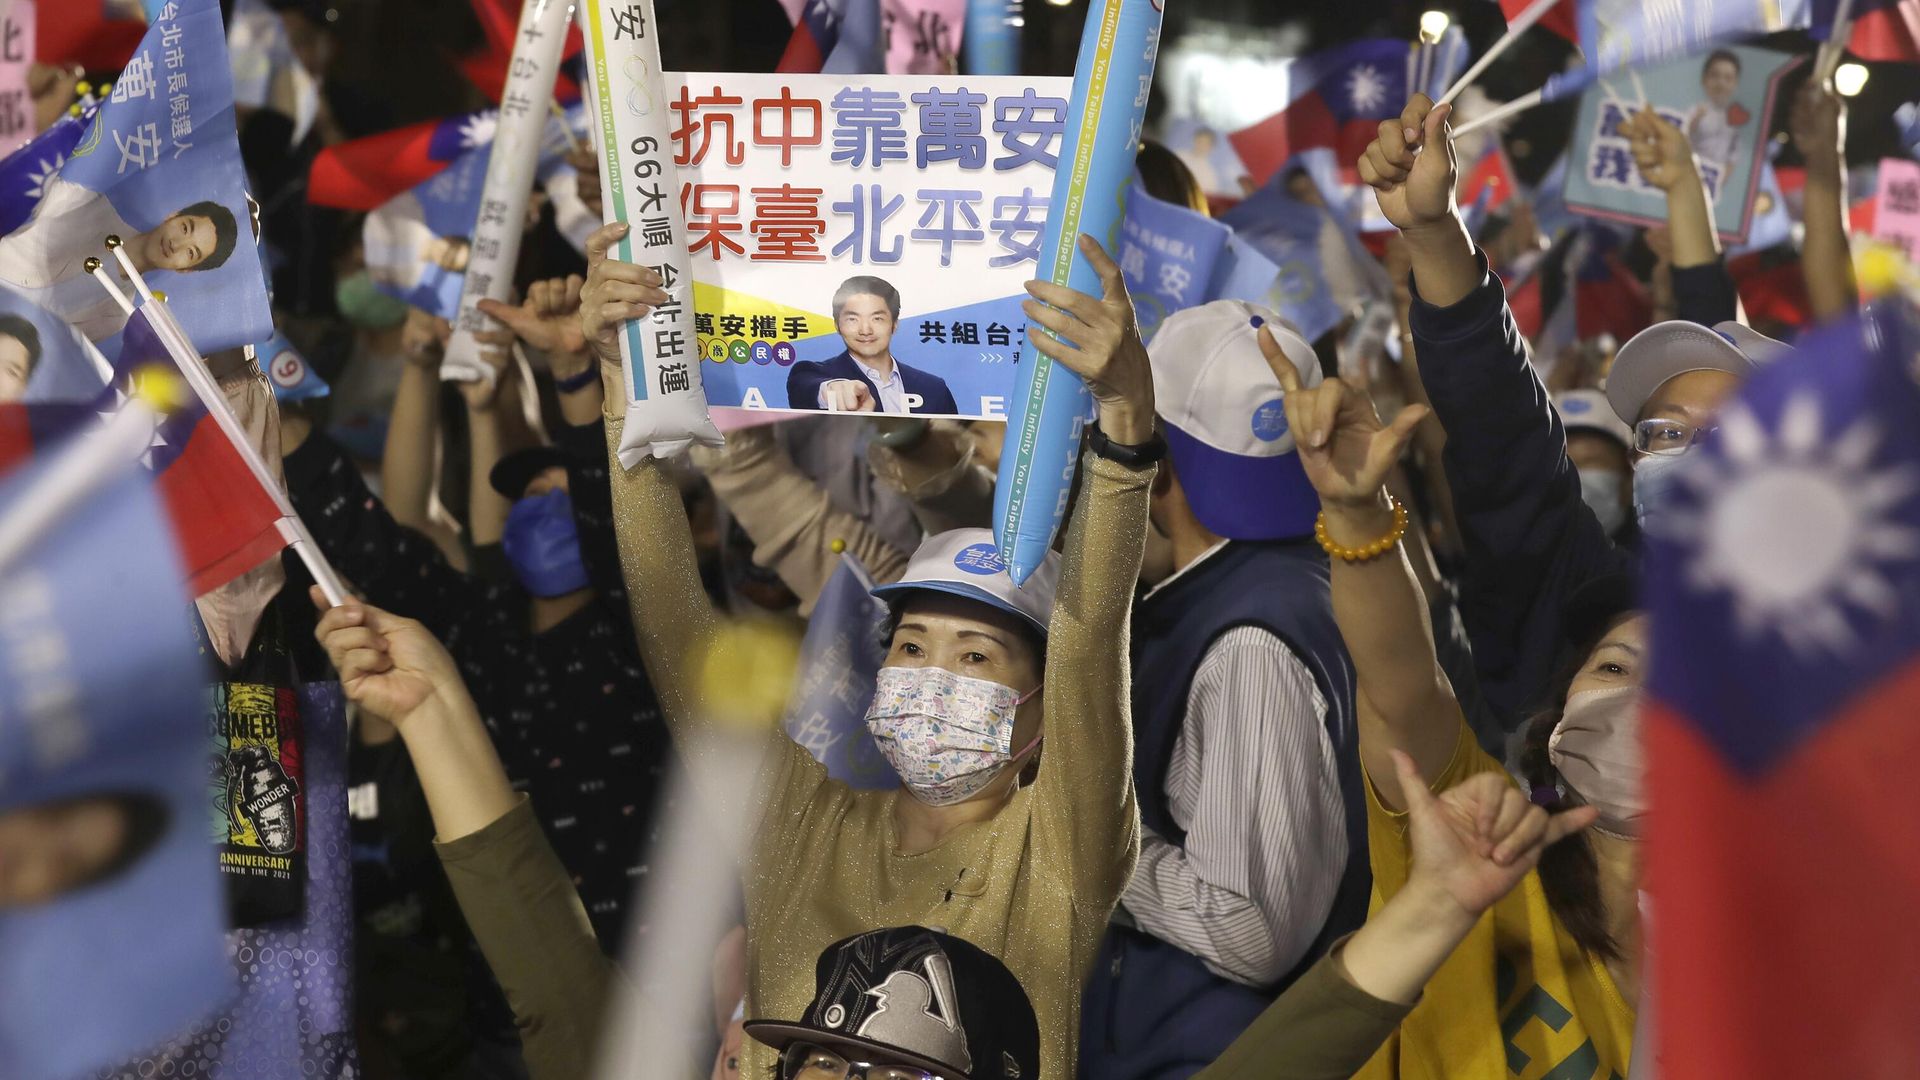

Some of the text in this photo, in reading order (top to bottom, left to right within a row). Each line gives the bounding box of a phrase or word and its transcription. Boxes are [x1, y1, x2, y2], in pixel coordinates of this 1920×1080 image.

[1100, 8, 1116, 50] Infinity
[158, 1, 193, 160] 台北市長候選人
[1095, 59, 1107, 81] You
[610, 4, 646, 41] 安
[631, 135, 673, 249] 66大順
[670, 85, 1068, 172] 抗中靠萬安
[1086, 94, 1101, 131] Taipei
[600, 96, 613, 135] Taipei
[608, 149, 620, 194] Infinity
[1074, 143, 1092, 187] Infinity
[1069, 194, 1080, 216] You
[679, 182, 1051, 268] 保臺北平安
[1060, 229, 1074, 264] Taipei
[695, 314, 809, 341] 萬安攜手
[1034, 364, 1047, 402] Taipei
[1023, 414, 1037, 456] Infinity
[1016, 464, 1028, 486] You
[1007, 499, 1021, 533] Taipei
[247, 783, 290, 815] WONDER
[219, 852, 291, 870] ANNIVERSARY
[220, 865, 290, 880] HONOR TIME 2021
